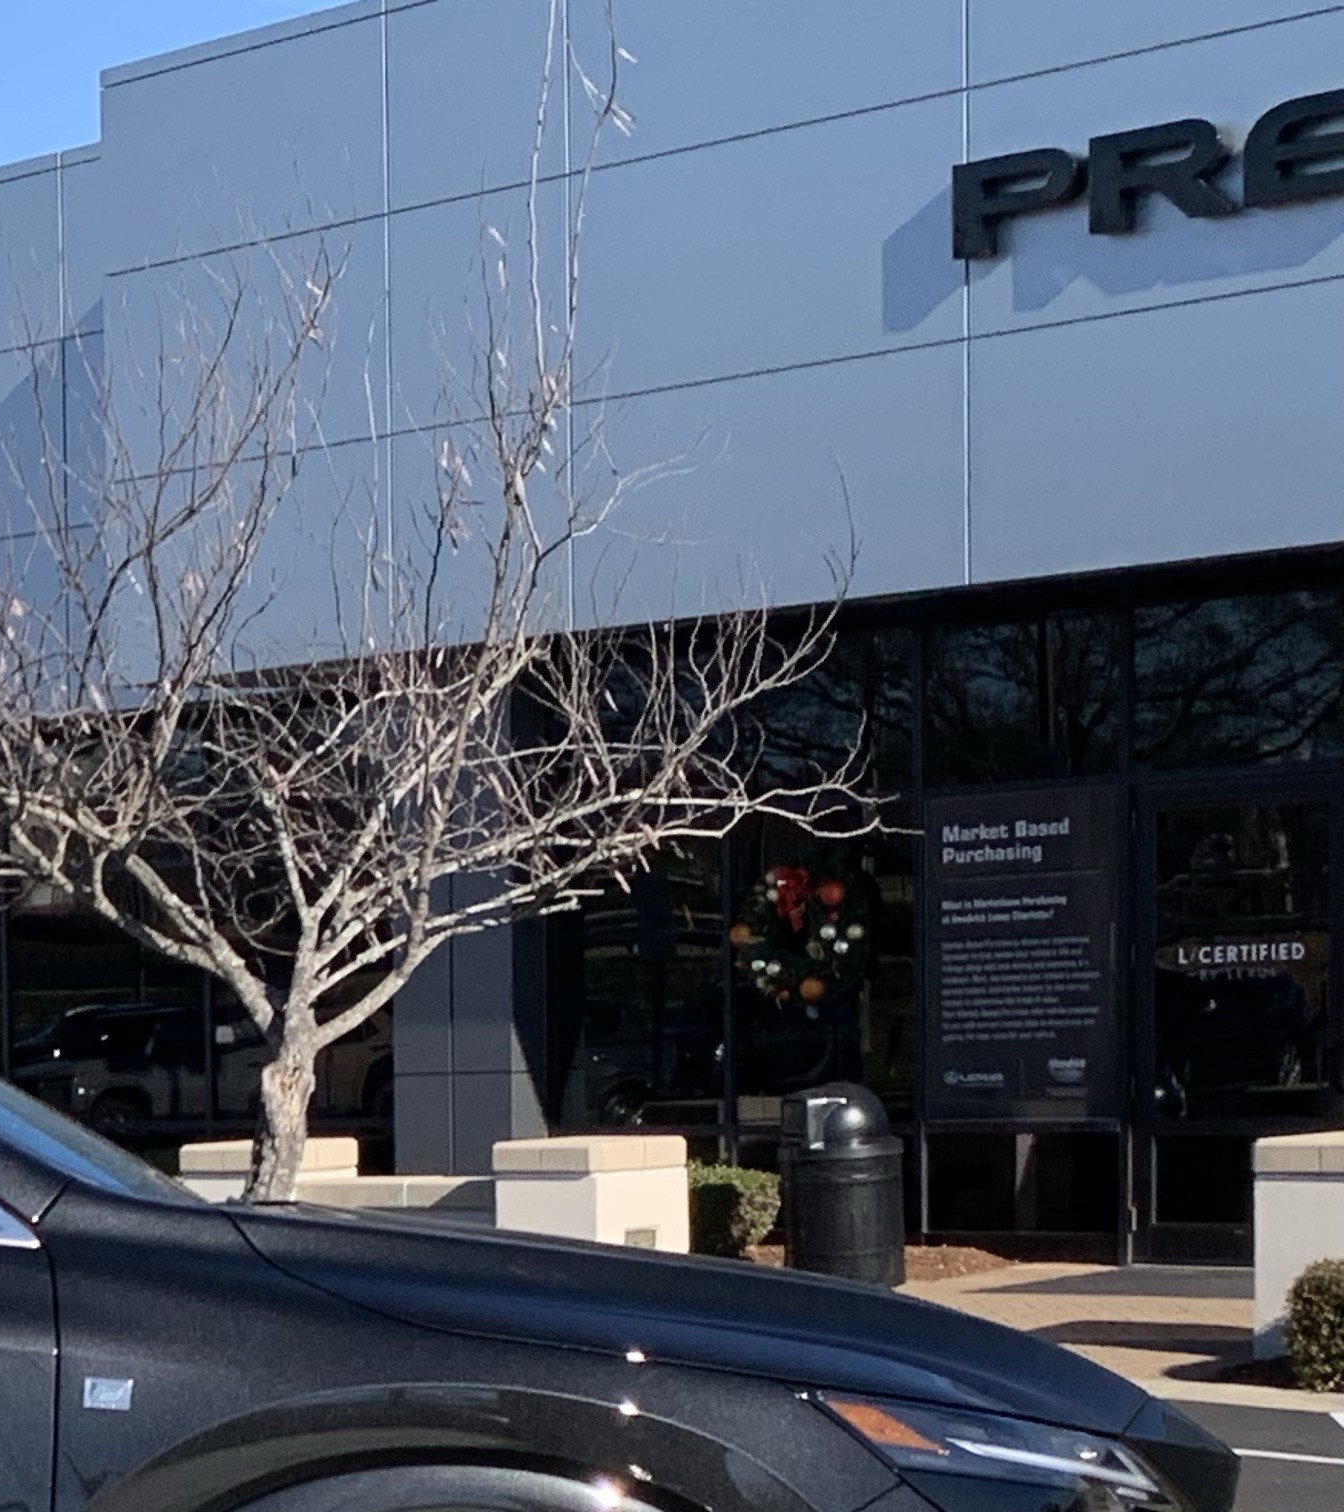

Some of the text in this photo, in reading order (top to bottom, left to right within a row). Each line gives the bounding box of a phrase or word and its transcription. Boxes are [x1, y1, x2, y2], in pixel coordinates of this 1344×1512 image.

[942, 817, 1070, 843] Market Based
[942, 842, 1042, 864] Purchasing
